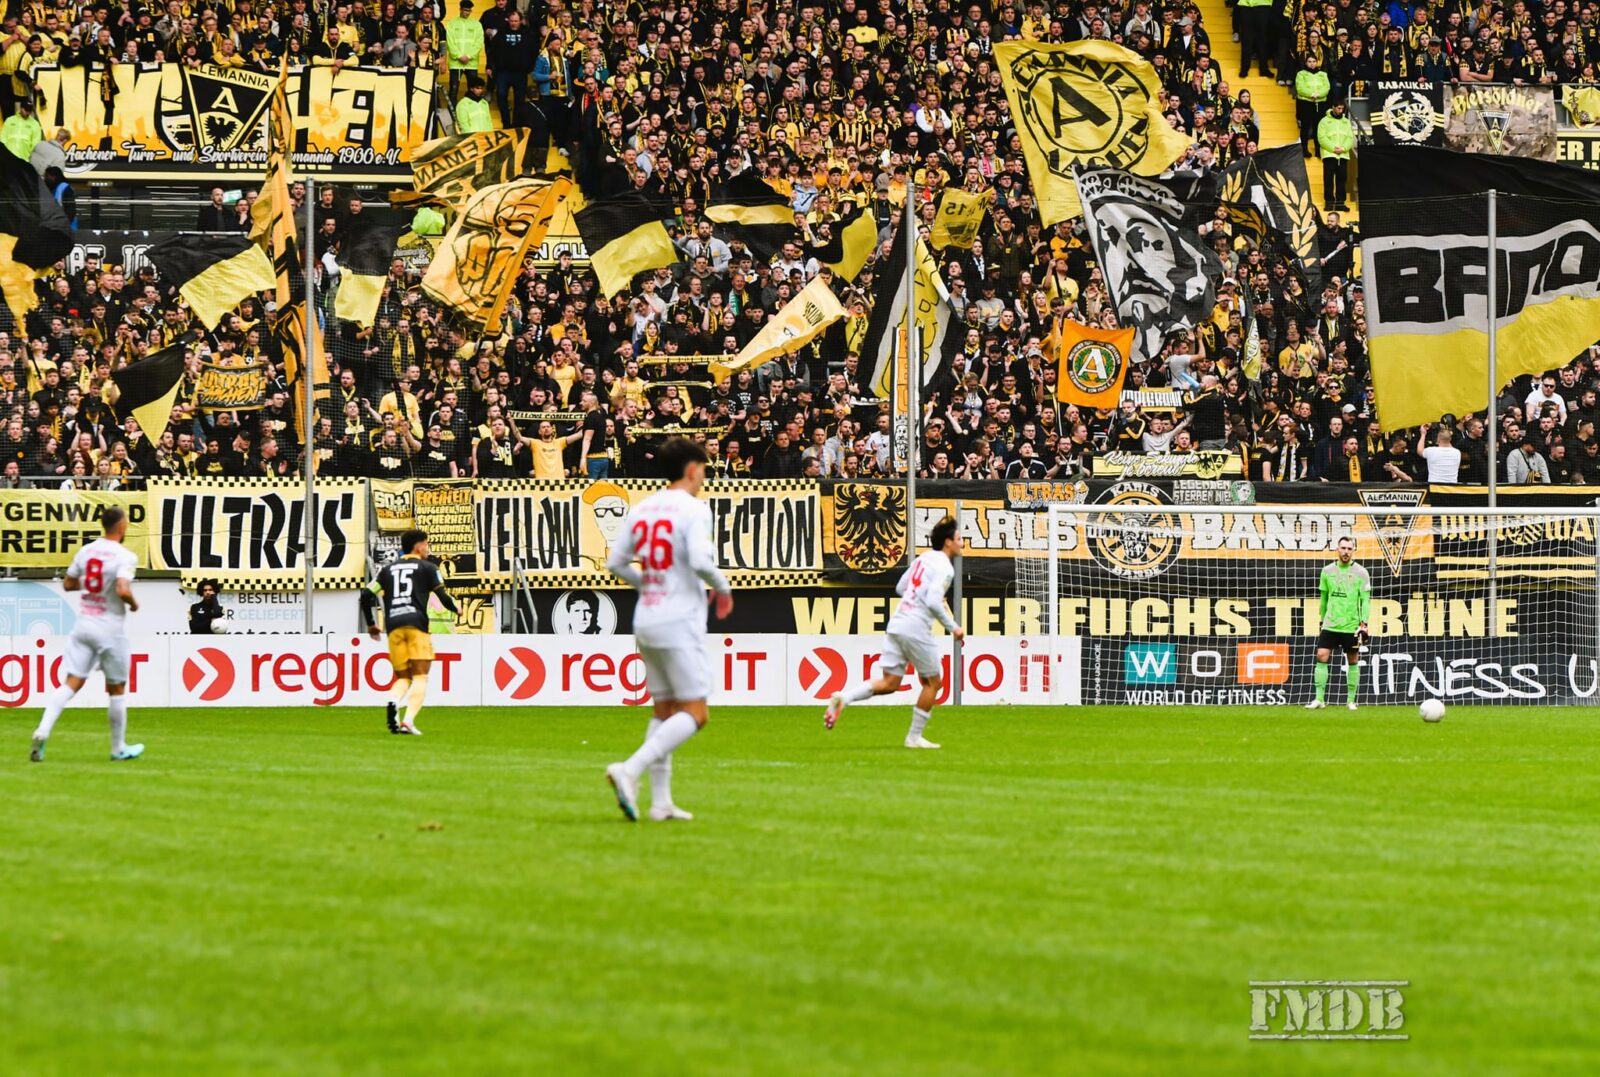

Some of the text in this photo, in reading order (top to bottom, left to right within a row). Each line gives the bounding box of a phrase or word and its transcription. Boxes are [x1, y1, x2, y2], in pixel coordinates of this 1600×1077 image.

[173, 150, 194, 161] und
[1374, 231, 1600, 324] BAND
[415, 489, 471, 505] FREIHEIT
[1366, 493, 1418, 502] ALEMANNIA
[161, 493, 354, 568] ULTRAS
[477, 496, 580, 572] YELLOW
[631, 519, 673, 571] 26
[84, 558, 104, 593] 8
[391, 569, 413, 597] 15
[238, 592, 302, 604] BESTELLT.
[1059, 597, 1252, 636] FUCHS
[724, 637, 767, 691] iT
[1126, 690, 1286, 705] WORLD OF FITNESS
